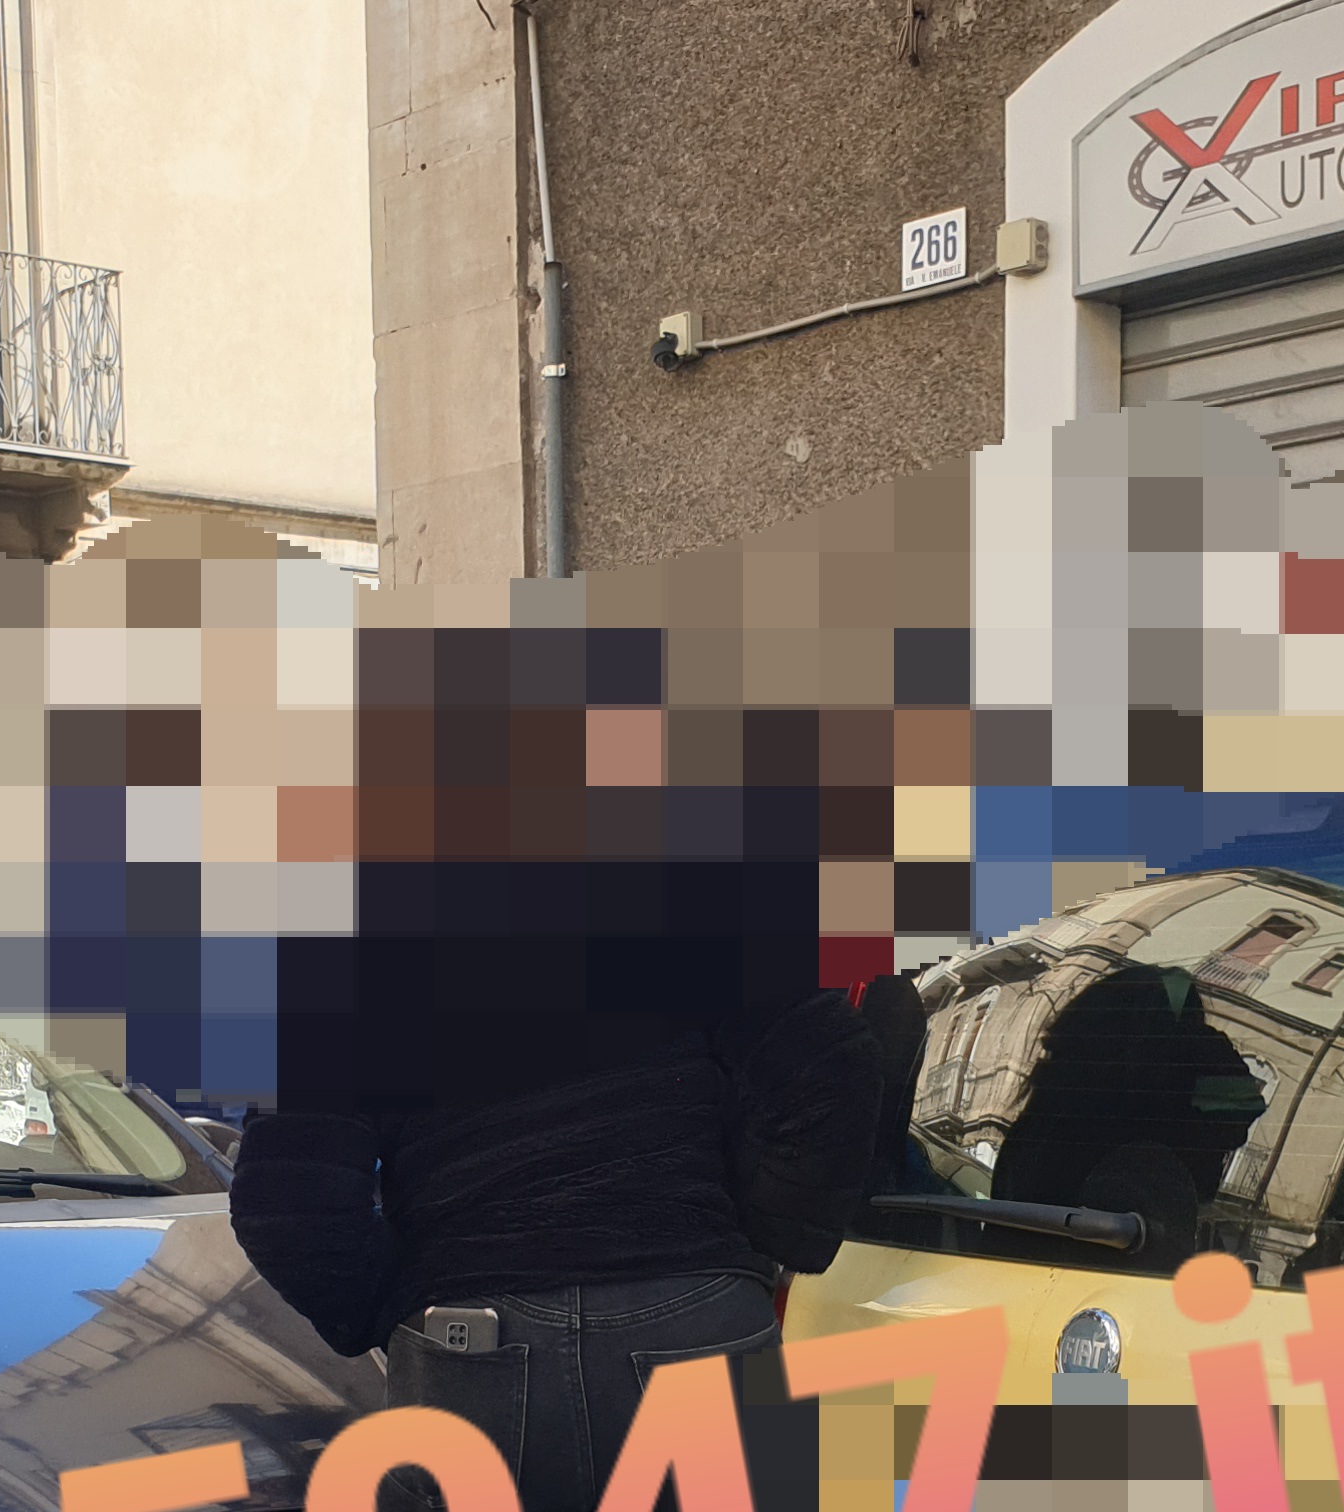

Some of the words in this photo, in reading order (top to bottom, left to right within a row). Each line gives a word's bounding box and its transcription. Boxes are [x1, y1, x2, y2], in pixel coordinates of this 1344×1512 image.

[910, 220, 958, 271] 266
[929, 263, 962, 282] EMANUELE
[1063, 1337, 1107, 1369] FIAT
